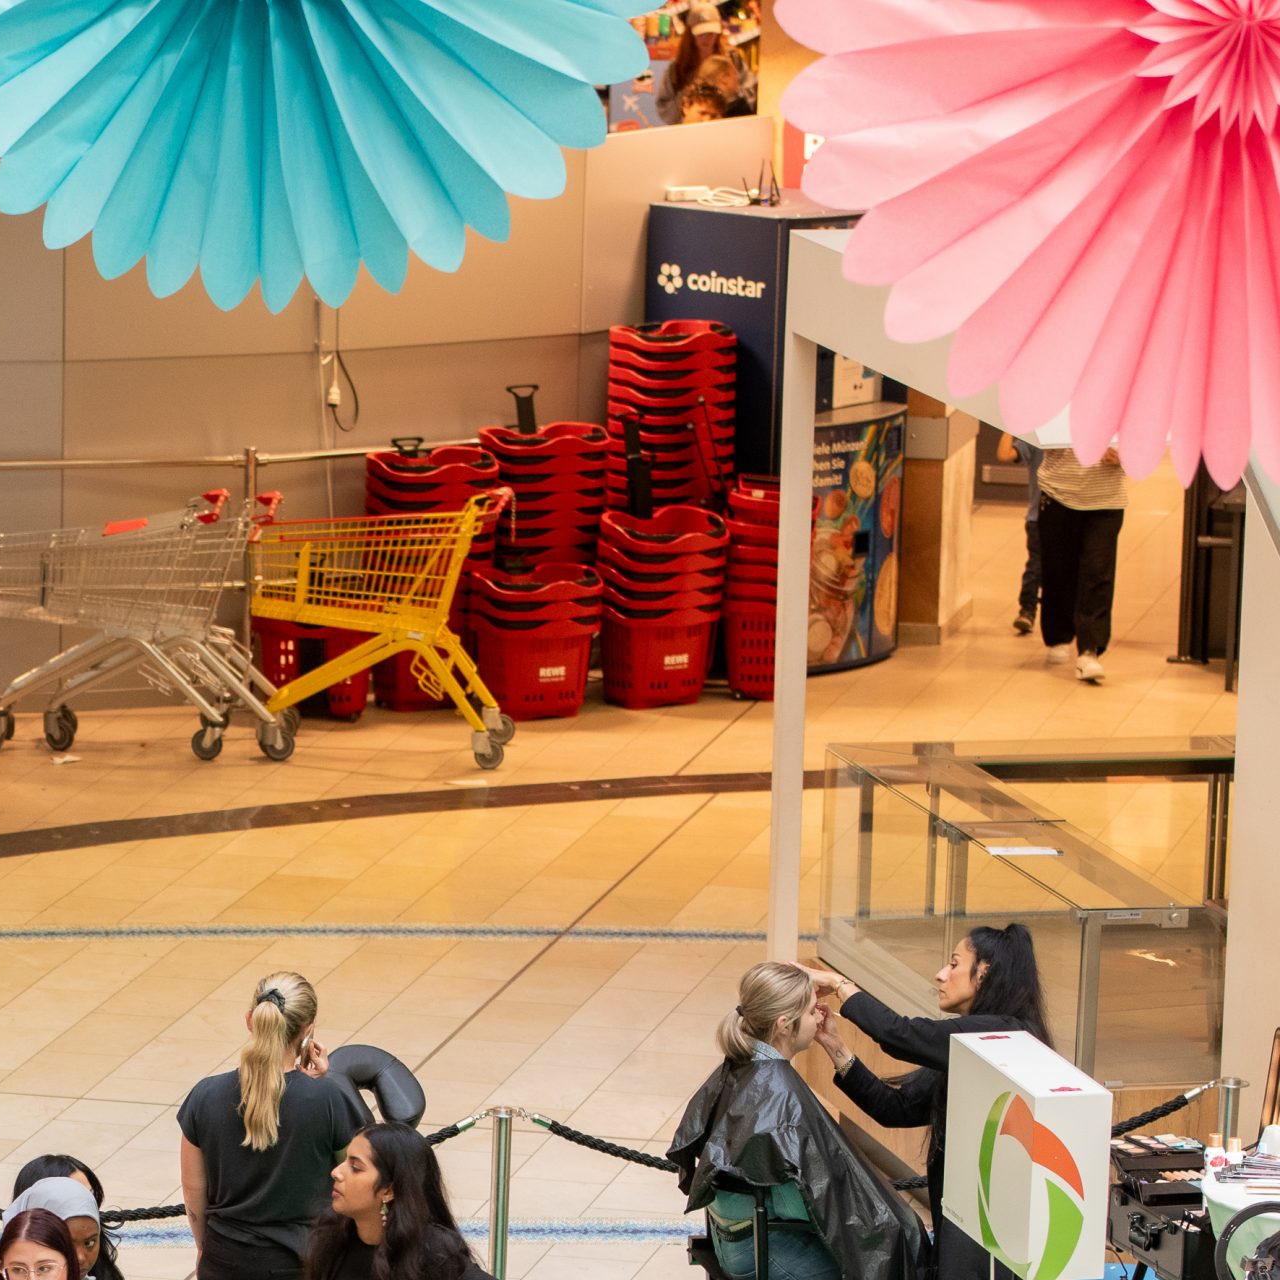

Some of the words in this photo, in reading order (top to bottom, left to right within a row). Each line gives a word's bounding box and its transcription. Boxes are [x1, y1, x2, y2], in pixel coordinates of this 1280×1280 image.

[687, 271, 766, 299] coinstar
[664, 653, 689, 665] REWE
[539, 666, 566, 677] REWE
